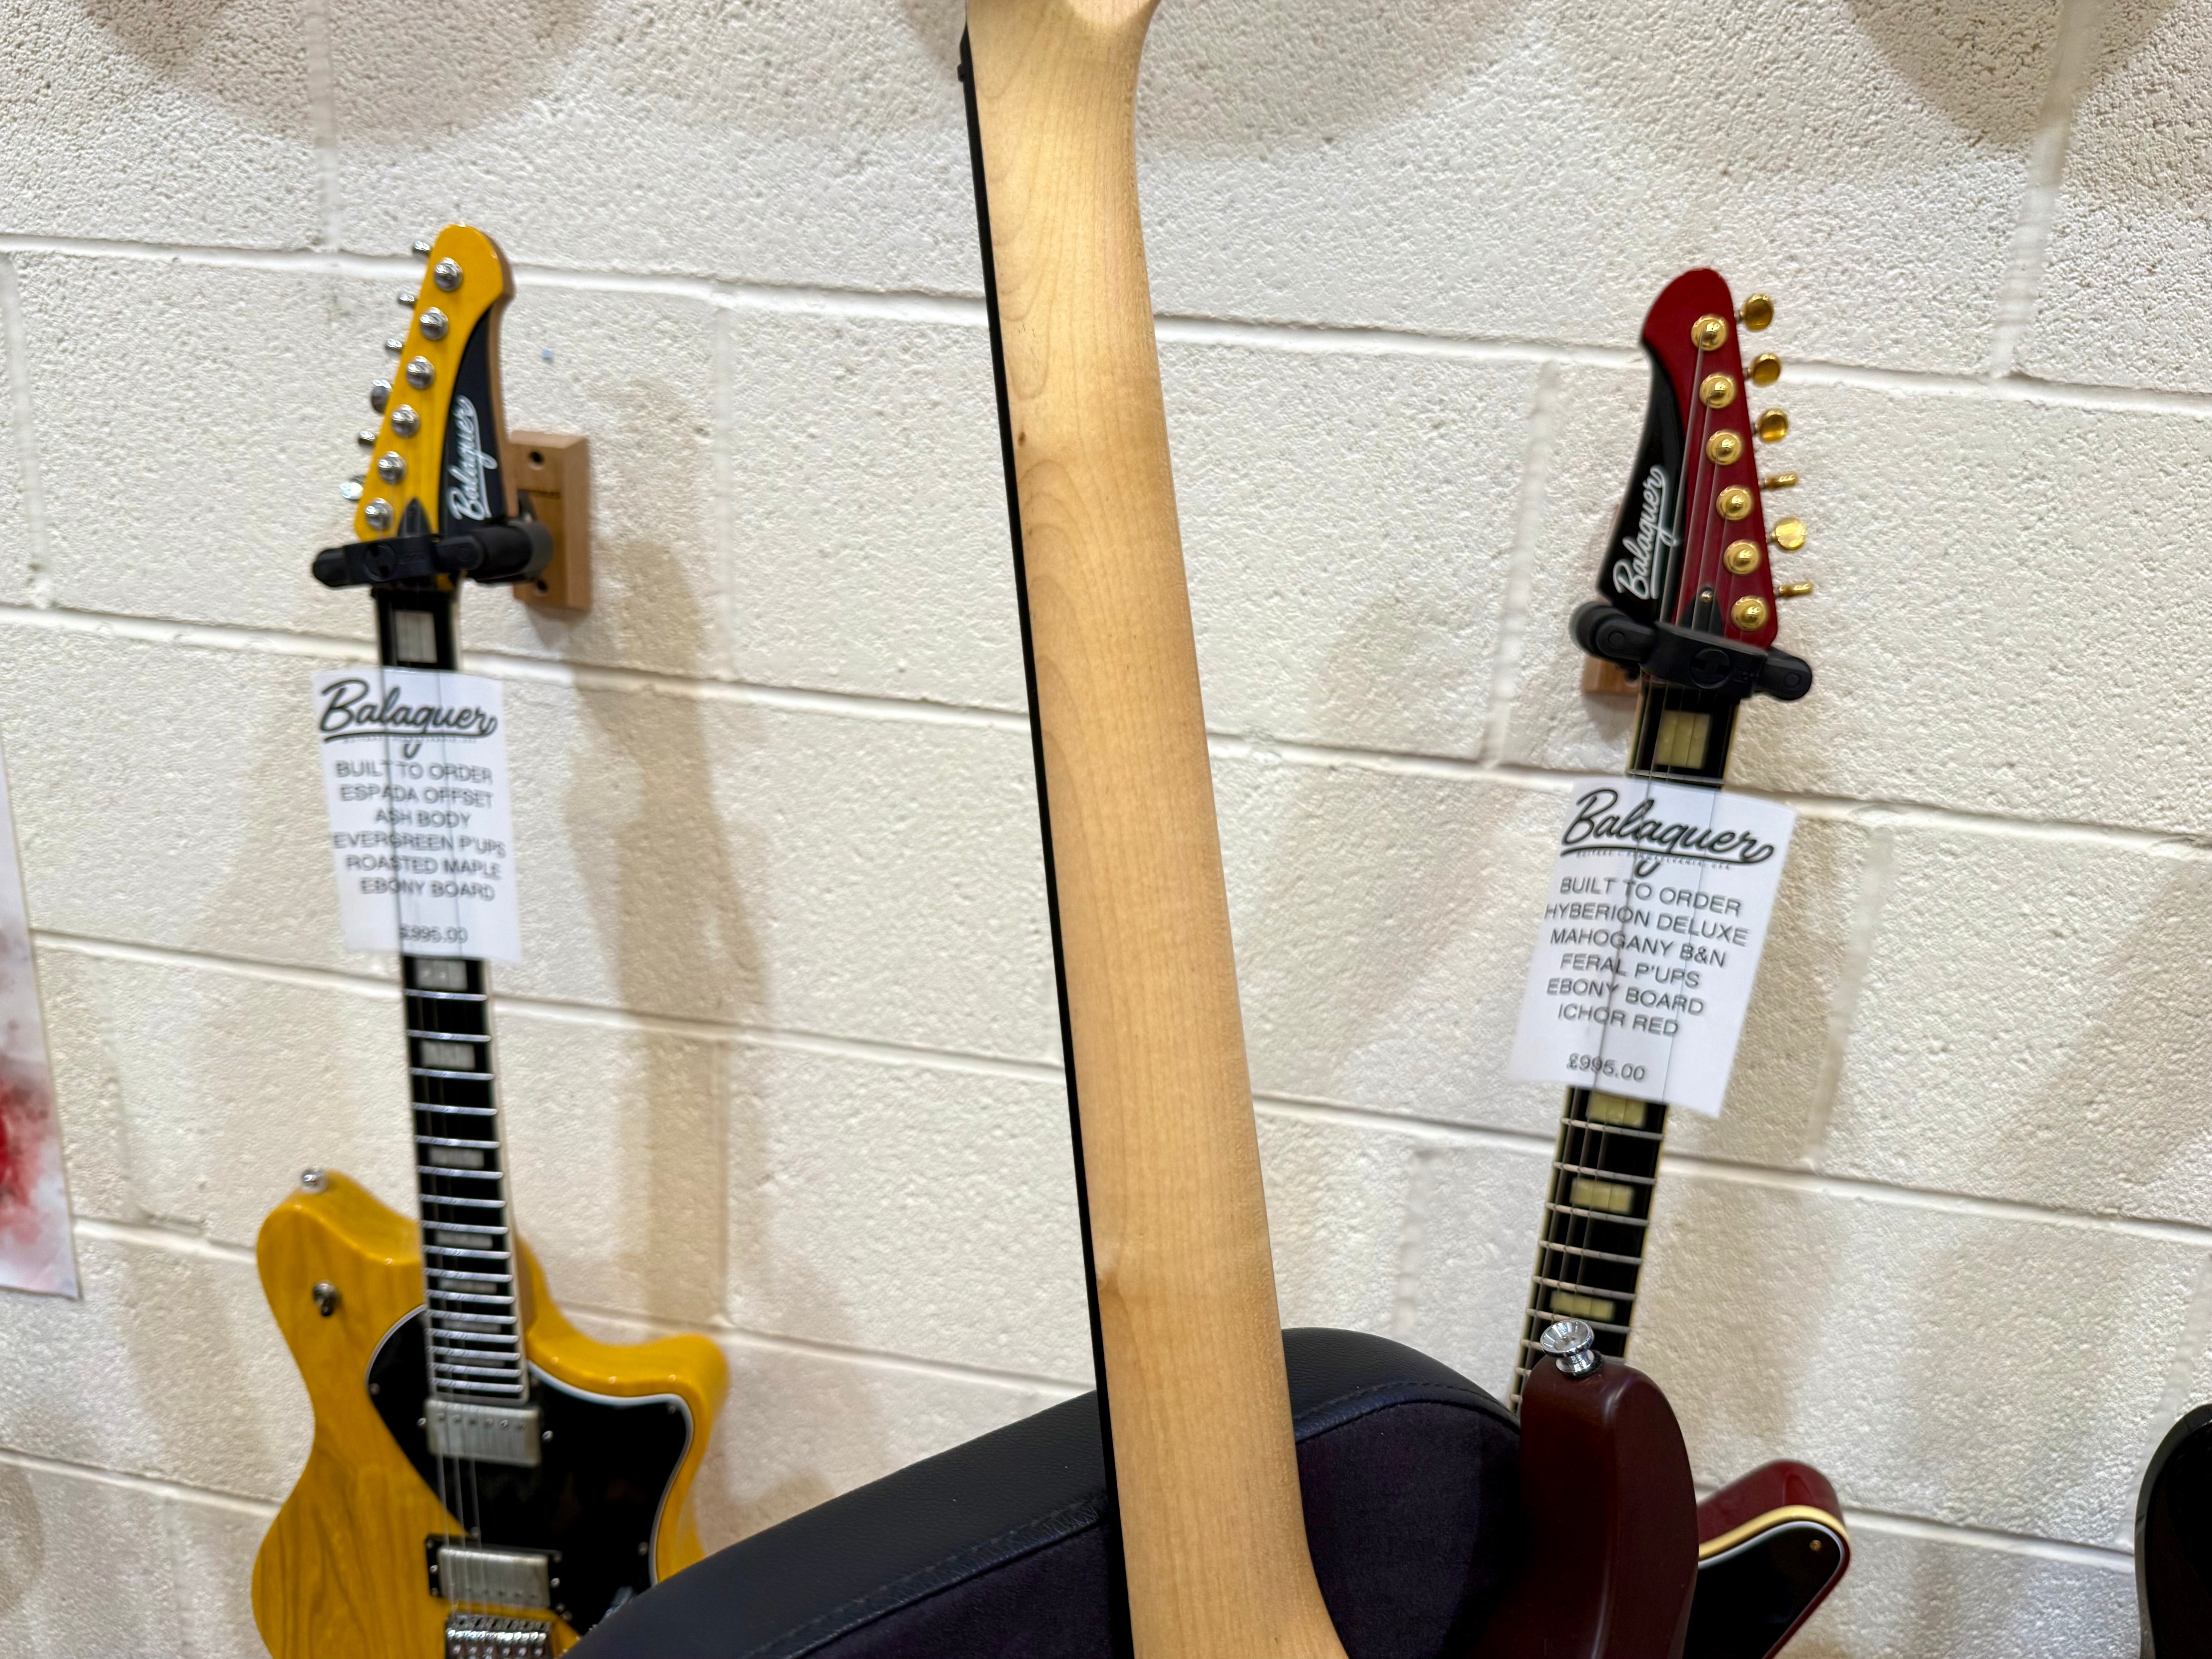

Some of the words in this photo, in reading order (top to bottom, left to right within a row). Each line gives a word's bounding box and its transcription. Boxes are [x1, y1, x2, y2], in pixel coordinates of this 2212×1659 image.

[447, 394, 498, 521] Balaguer
[1613, 465, 1678, 600] Balaguer
[320, 679, 498, 758] Balaguer
[335, 760, 392, 778] BUILT
[395, 761, 424, 779] TO
[428, 762, 493, 785] ORDER
[340, 783, 419, 802] ESPADA
[423, 786, 494, 809] OFFSET
[375, 809, 412, 825] ASH
[417, 810, 471, 828] BODY
[1559, 788, 1774, 879] Balaguer
[333, 831, 454, 851] EVERGREEN
[346, 854, 438, 874] ROASTED
[443, 858, 503, 880] MAPLE
[360, 876, 425, 895] EBONY
[431, 880, 496, 901] BOARD
[1559, 876, 1617, 895] BUILT
[1623, 878, 1652, 900] TO
[1659, 886, 1742, 917] ORDER
[1544, 902, 1650, 927] HYBERION
[1657, 913, 1750, 947] DELUXE
[1550, 928, 1673, 956] MAHOGANY
[1679, 943, 1726, 967] B&N
[1561, 953, 1628, 976] FERAL
[1635, 962, 1701, 989] P'UPS
[1547, 977, 1619, 997] EBONY
[1625, 986, 1705, 1015] BOARD
[1558, 1003, 1626, 1027] ICHOR
[1633, 1014, 1678, 1036] RED
[1566, 1053, 1646, 1082] £995.00
